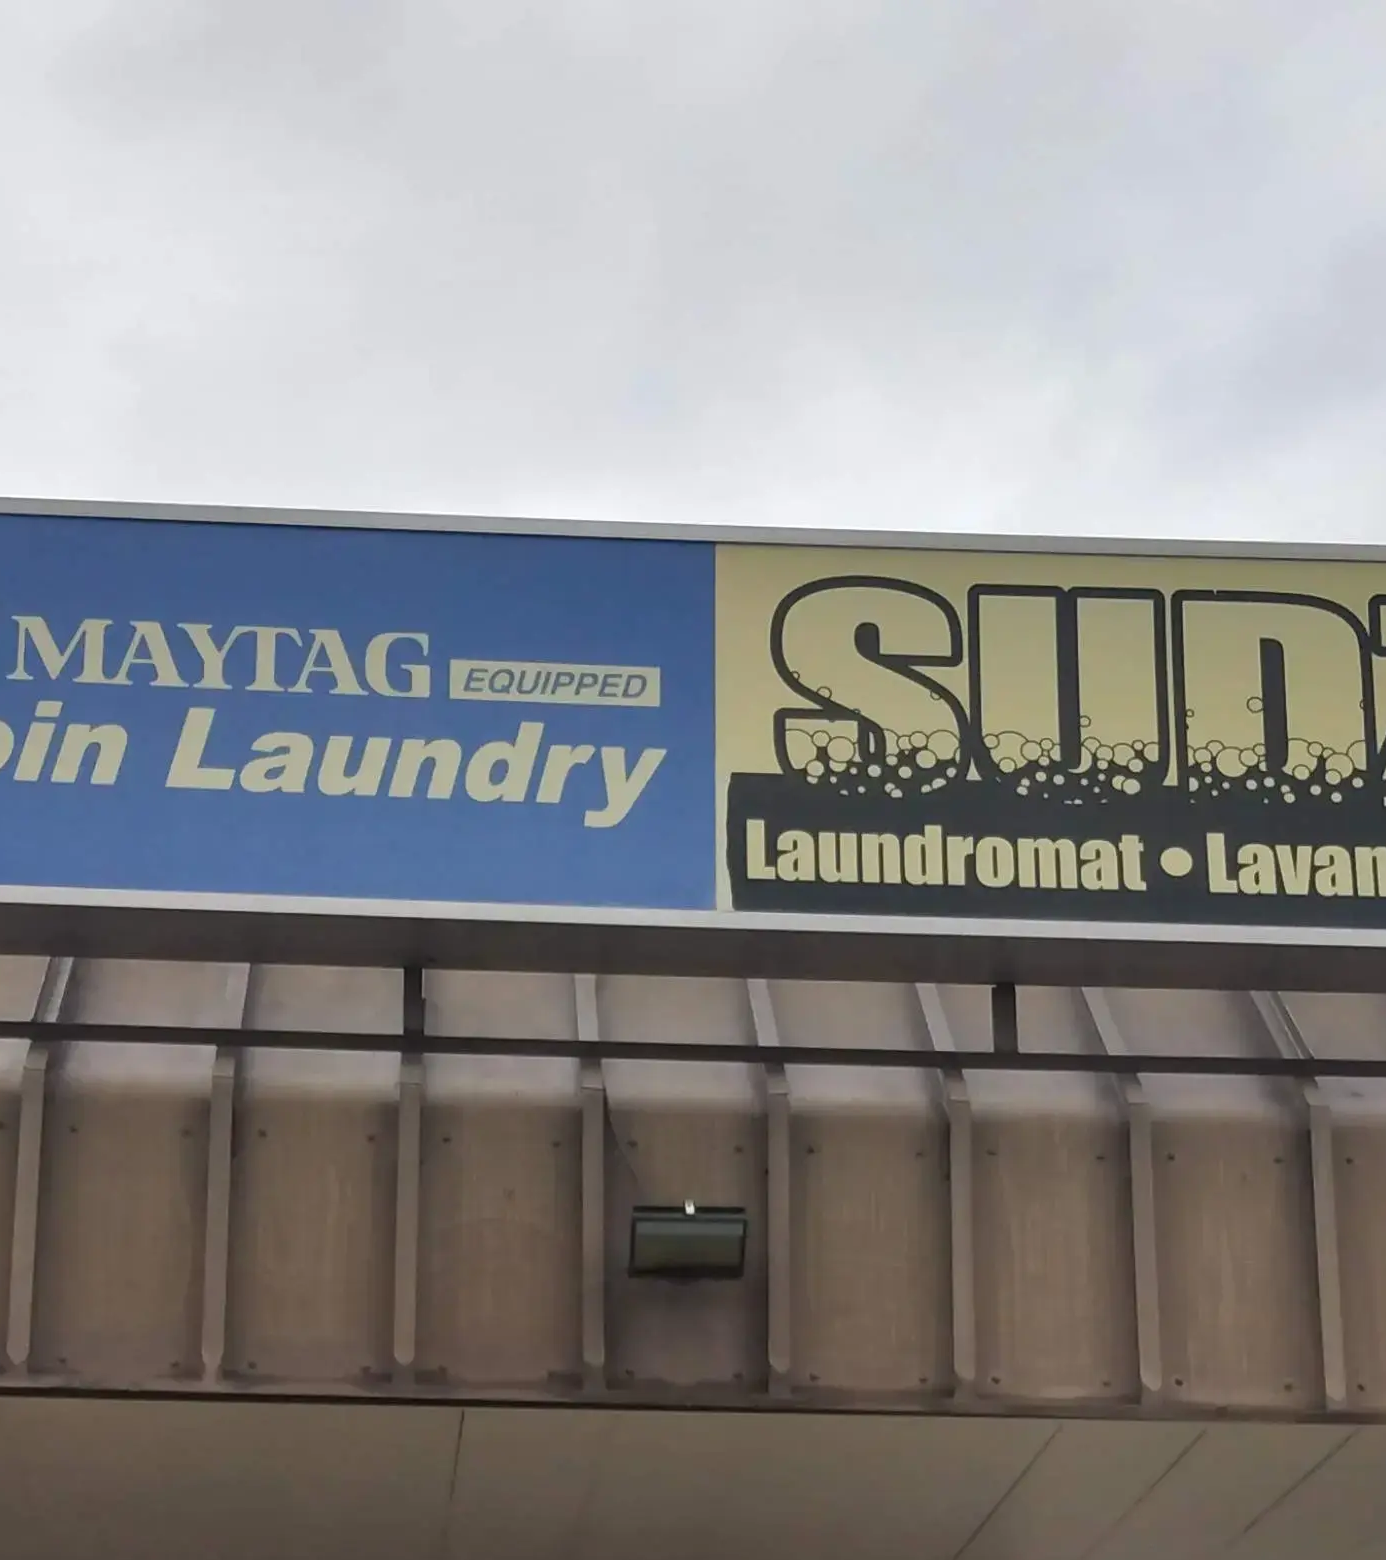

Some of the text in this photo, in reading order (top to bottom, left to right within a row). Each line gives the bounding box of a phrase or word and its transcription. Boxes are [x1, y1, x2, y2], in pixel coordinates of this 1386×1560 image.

[7, 614, 649, 700] MAYTAG EQUIPPED
[164, 707, 667, 828] Laundry
[745, 819, 1147, 892] Laundromat
